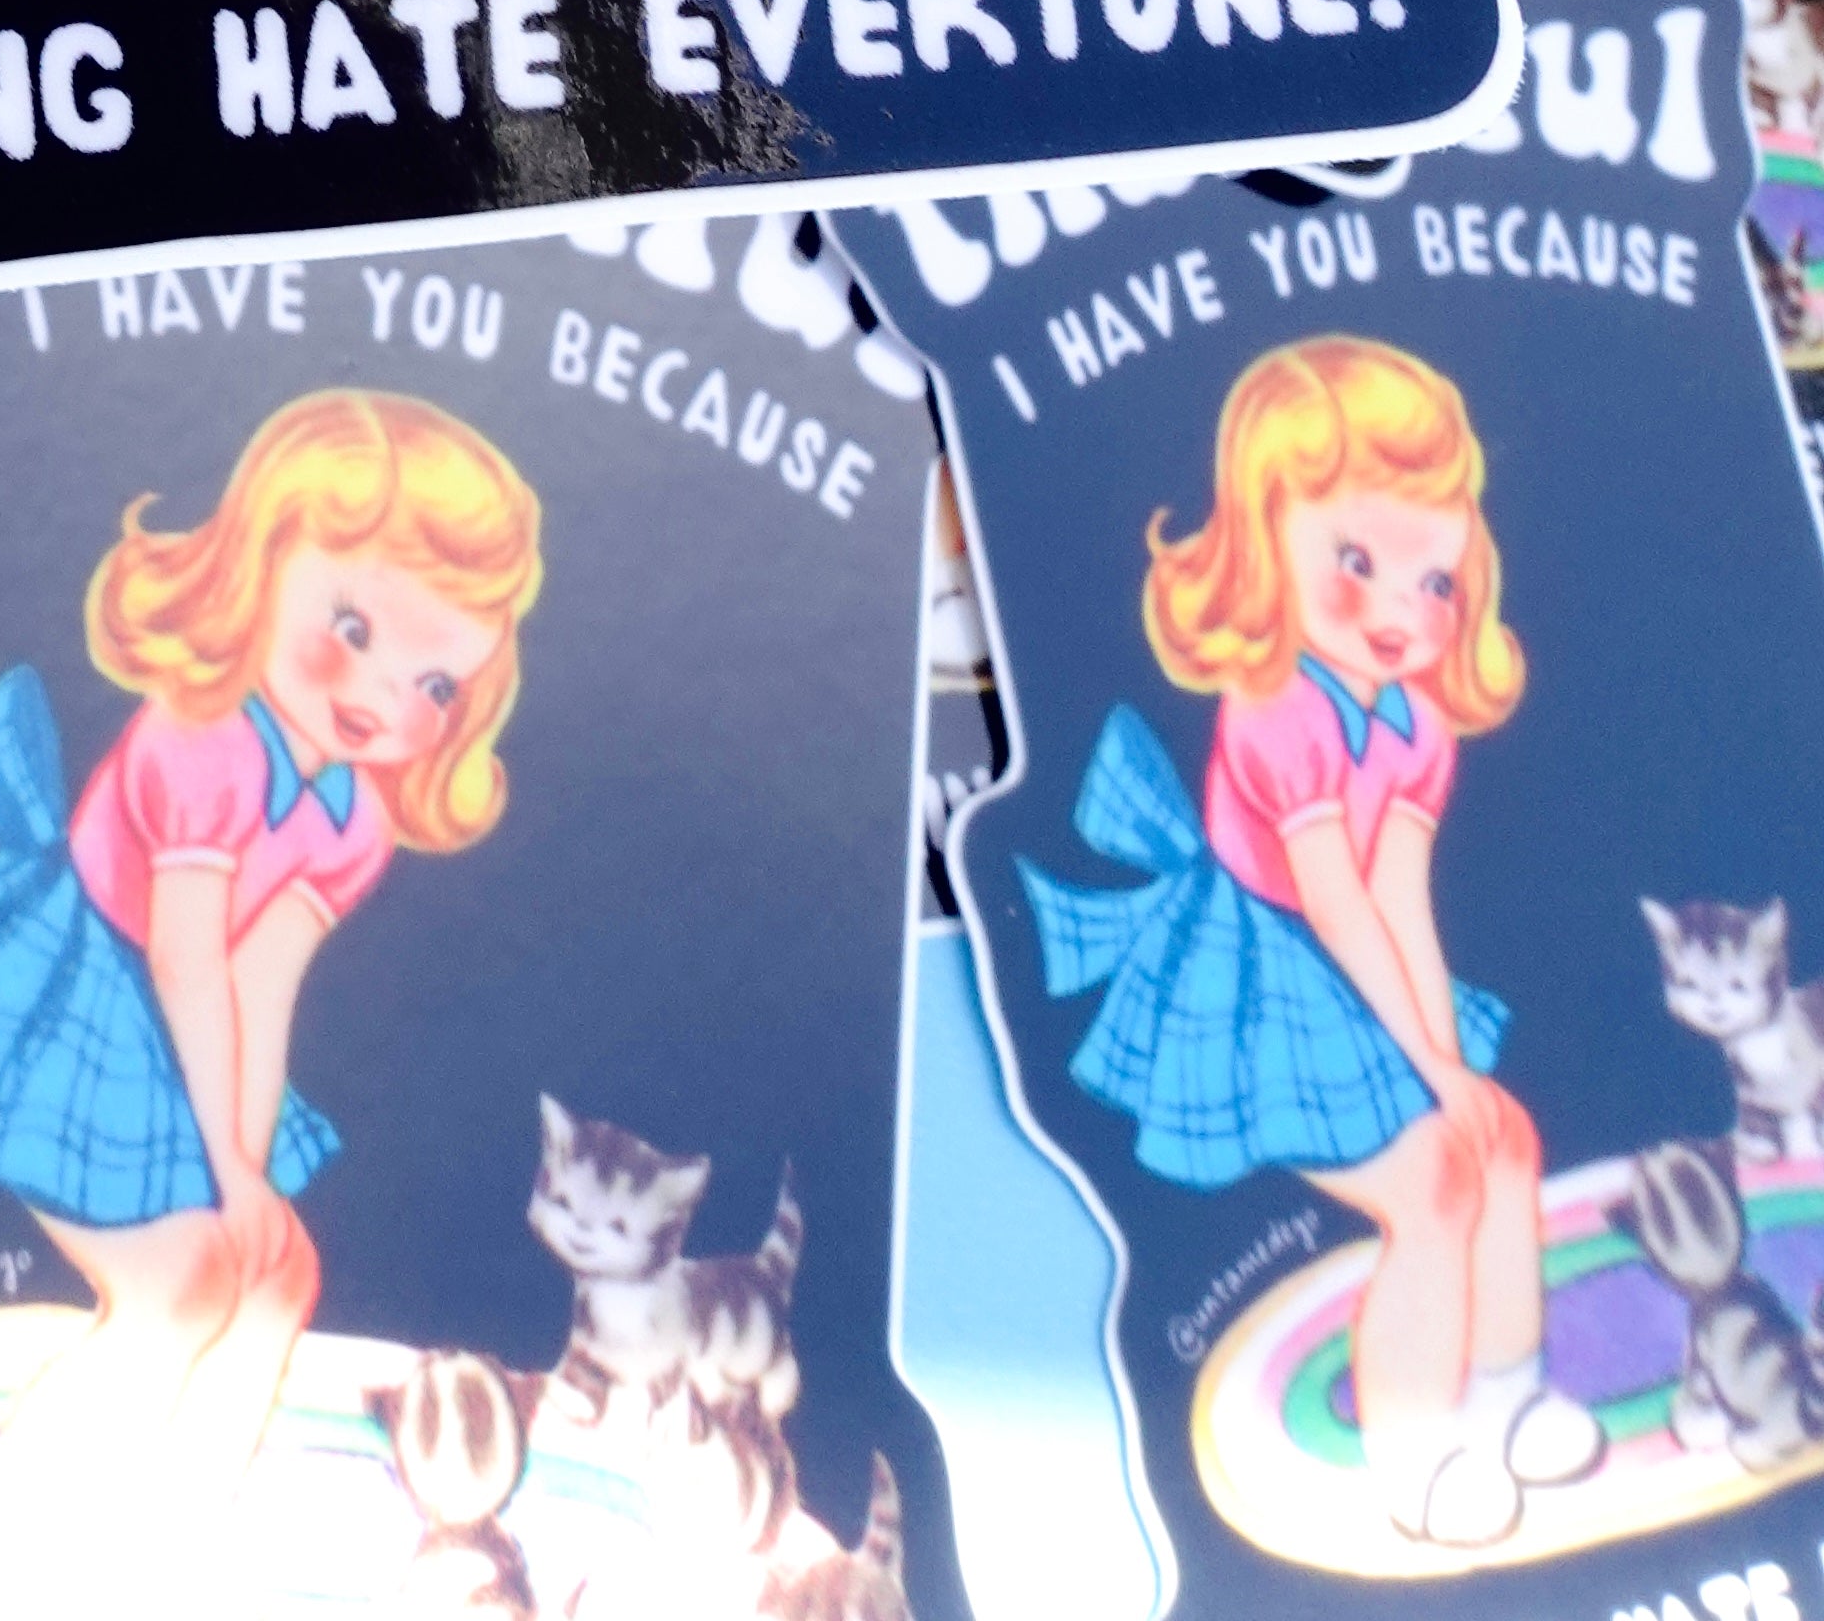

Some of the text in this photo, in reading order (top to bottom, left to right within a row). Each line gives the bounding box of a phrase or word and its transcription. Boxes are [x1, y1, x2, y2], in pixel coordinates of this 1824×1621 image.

[98, 261, 307, 339] HAVE
[361, 265, 504, 361] YOU
[549, 309, 879, 520] BECAUSE
[992, 354, 1037, 425] I
[1046, 247, 1225, 388] HAVE
[1248, 210, 1377, 300] YOU
[1412, 204, 1699, 306] BECAUSE
